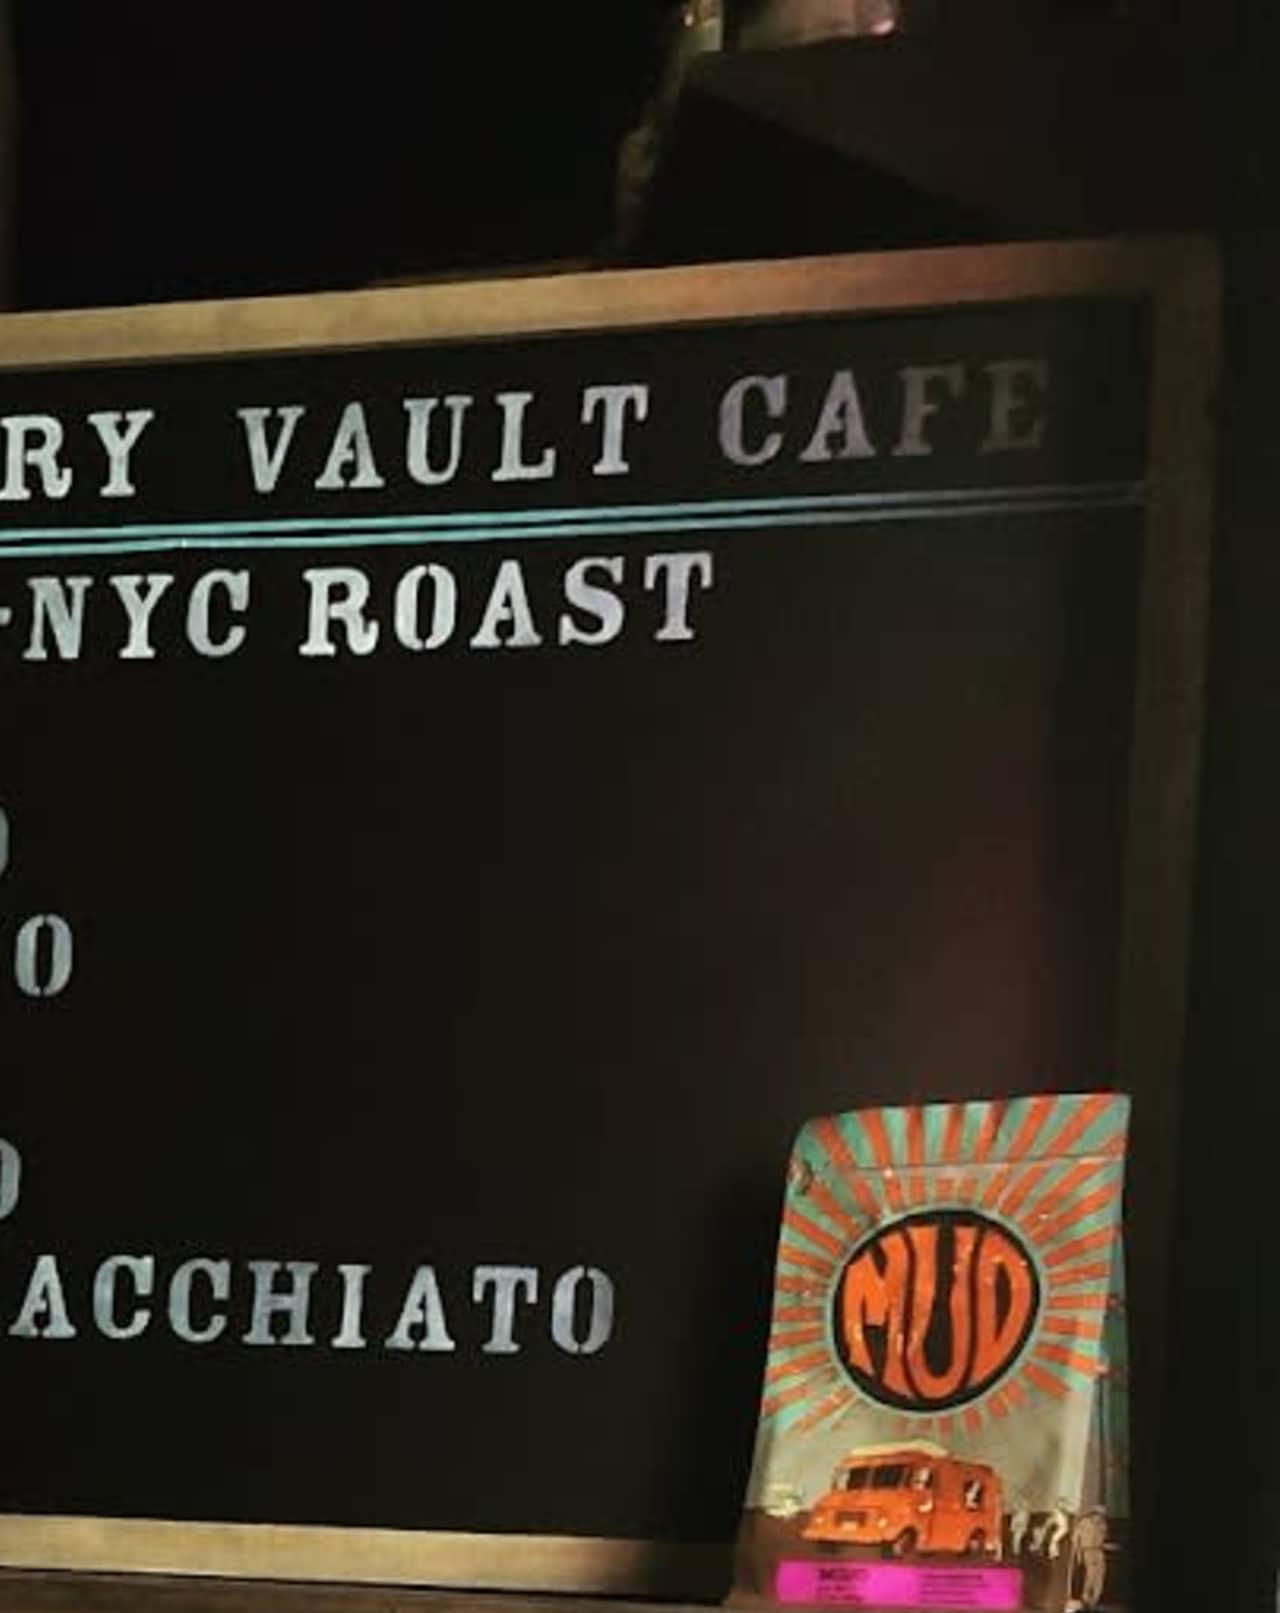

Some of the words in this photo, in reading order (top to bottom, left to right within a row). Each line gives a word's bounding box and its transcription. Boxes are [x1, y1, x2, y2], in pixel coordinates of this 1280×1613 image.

[236, 383, 649, 495] VAULT
[716, 358, 1048, 467] CAFE
[298, 549, 715, 659] ROAST
[841, 1222, 1039, 1401] MUD
